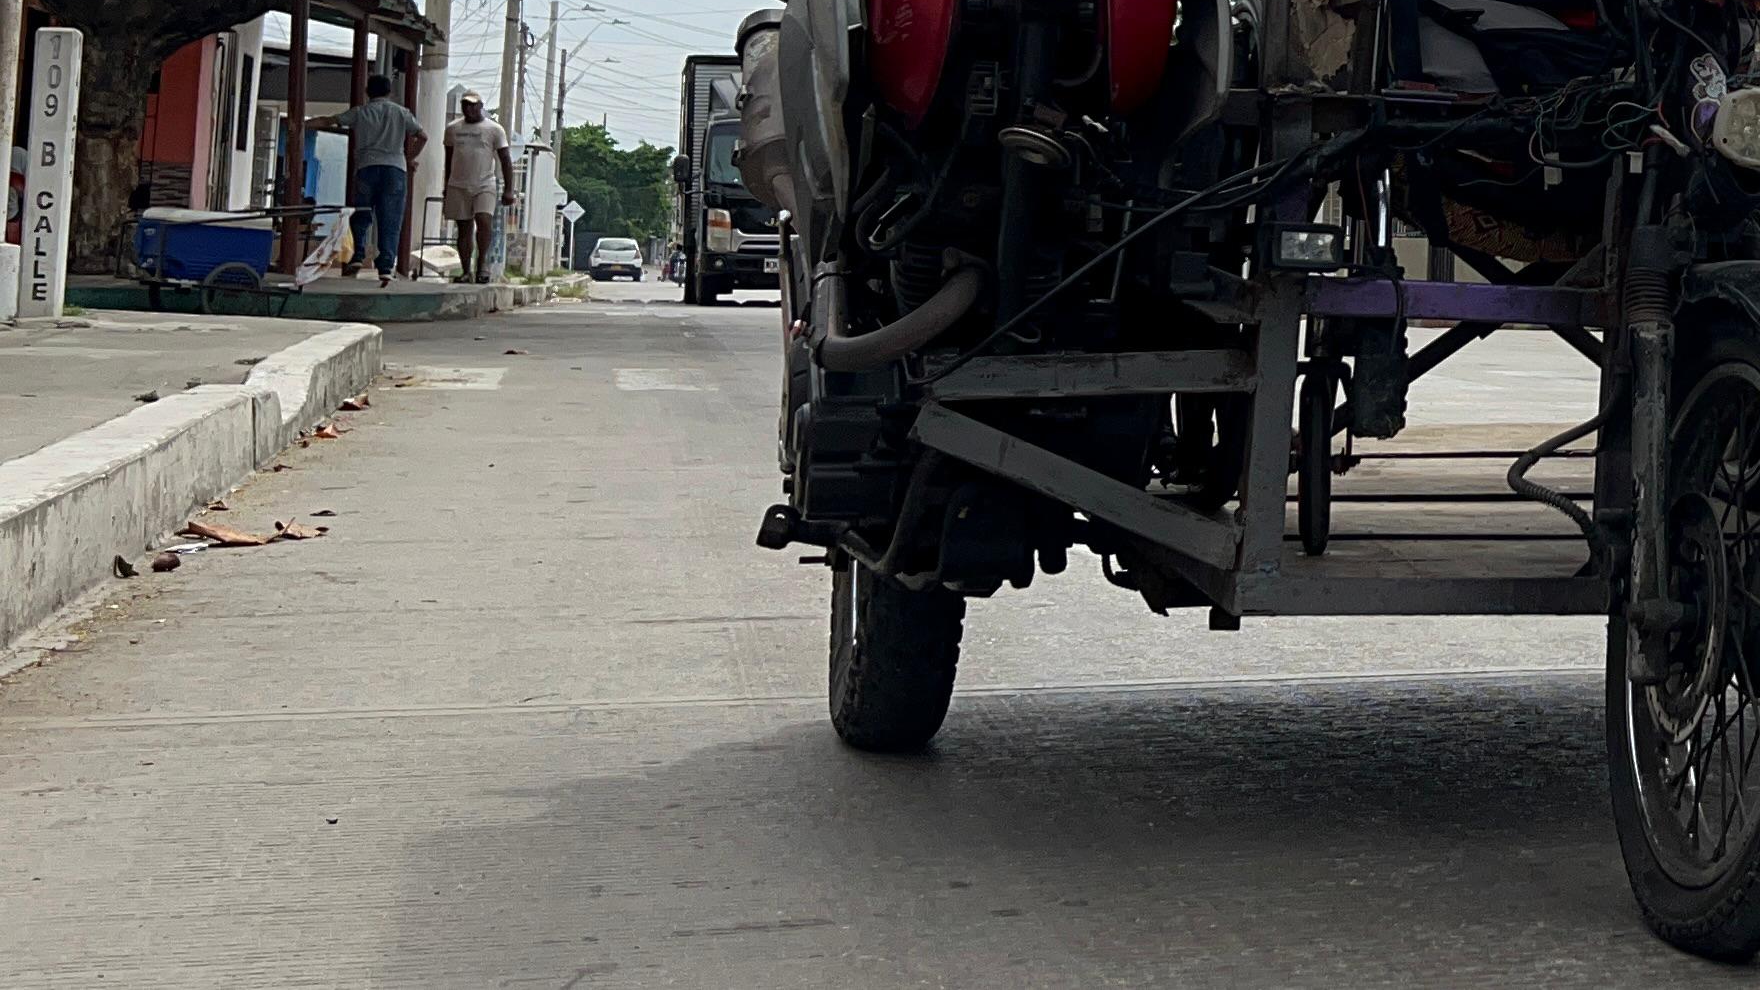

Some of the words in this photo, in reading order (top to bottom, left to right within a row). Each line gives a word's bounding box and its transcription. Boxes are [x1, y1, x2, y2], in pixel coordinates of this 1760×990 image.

[43, 34, 62, 118] 109
[40, 141, 56, 168] B
[31, 190, 54, 302] CALLE
